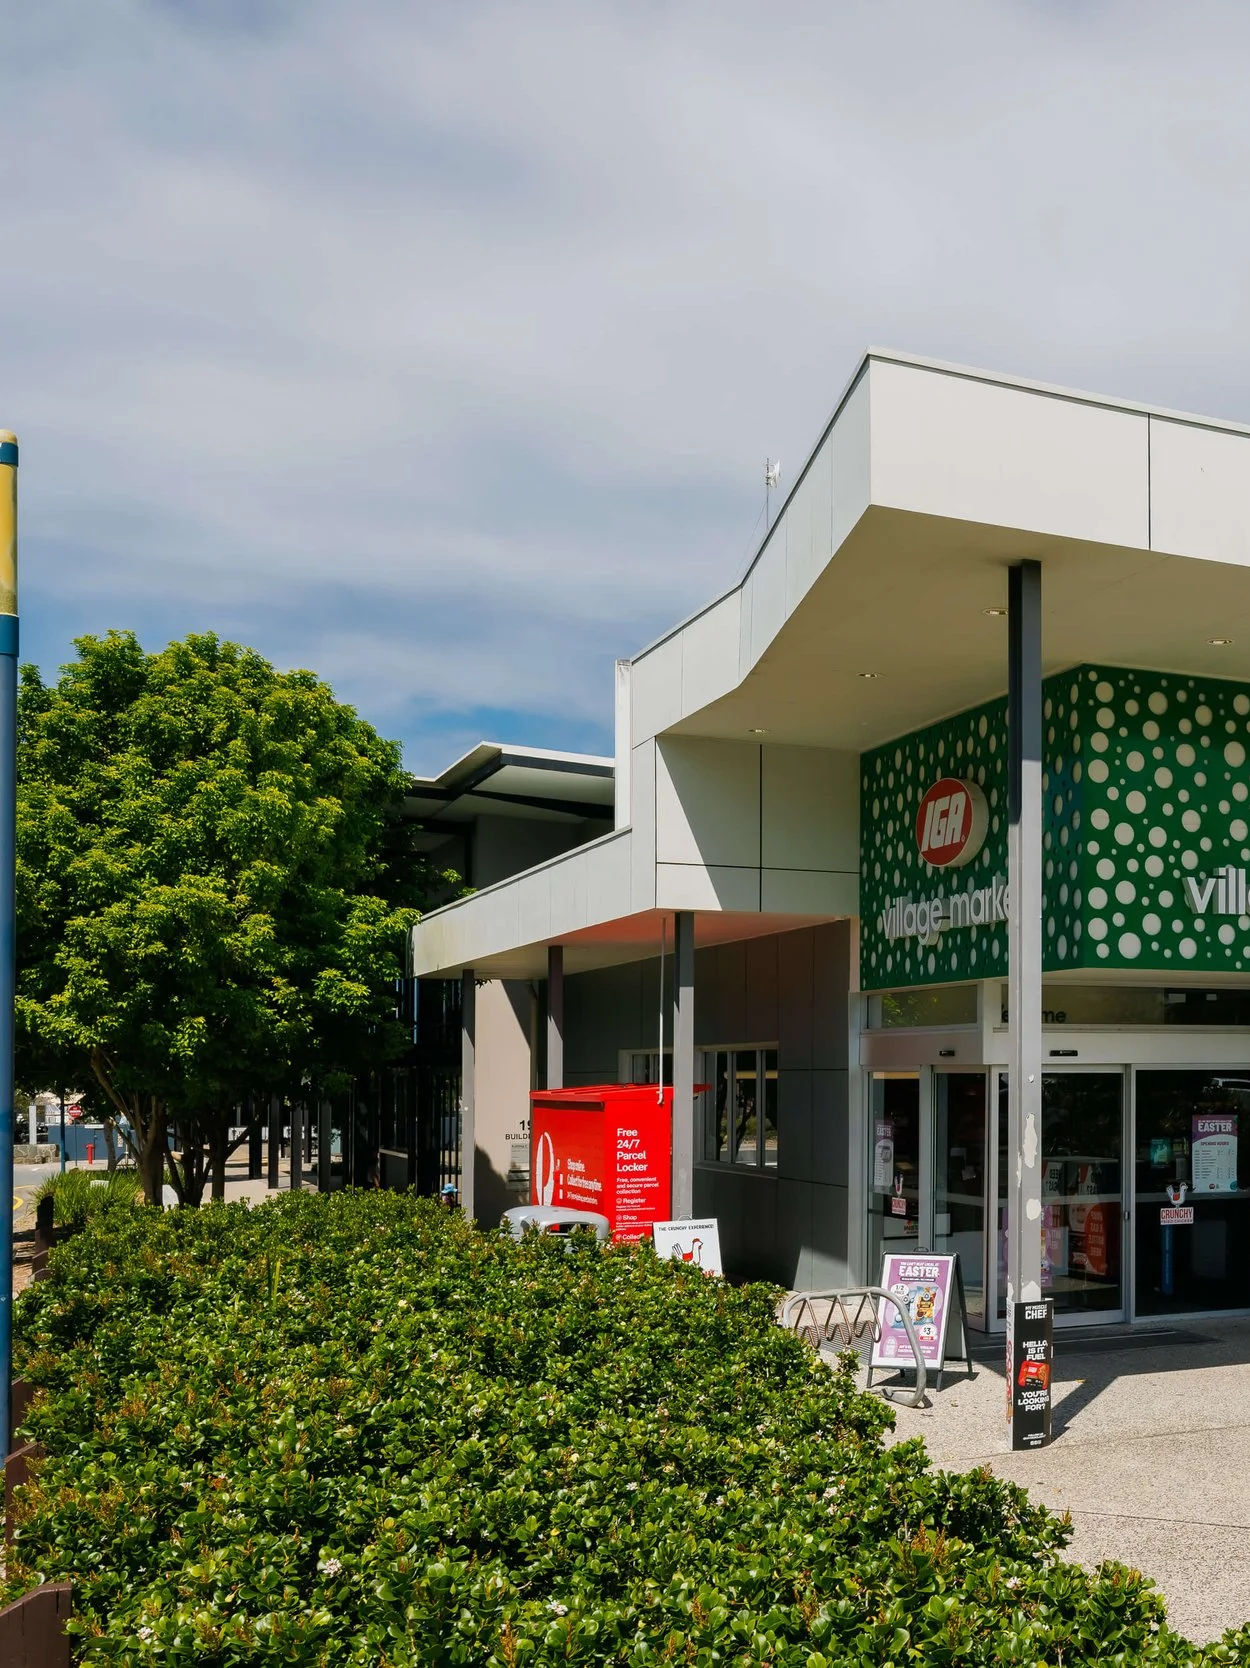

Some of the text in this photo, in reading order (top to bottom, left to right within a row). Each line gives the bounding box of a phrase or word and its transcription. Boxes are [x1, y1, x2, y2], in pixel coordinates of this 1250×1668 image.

[922, 791, 966, 849] IGA
[882, 876, 1009, 945] village mark
[617, 1128, 637, 1137] Free
[1198, 1123, 1232, 1132] EASTER
[617, 1139, 640, 1149] 24/7
[617, 1150, 646, 1160] Parcel
[617, 1162, 648, 1172] Locker
[1162, 1209, 1192, 1219] CRUNCHY
[899, 1266, 939, 1277] EASTER
[1025, 1309, 1047, 1320] CHEF
[924, 1327, 930, 1335] $3
[1022, 1340, 1048, 1348] HELLO,
[1025, 1403, 1045, 1412] FOR?
